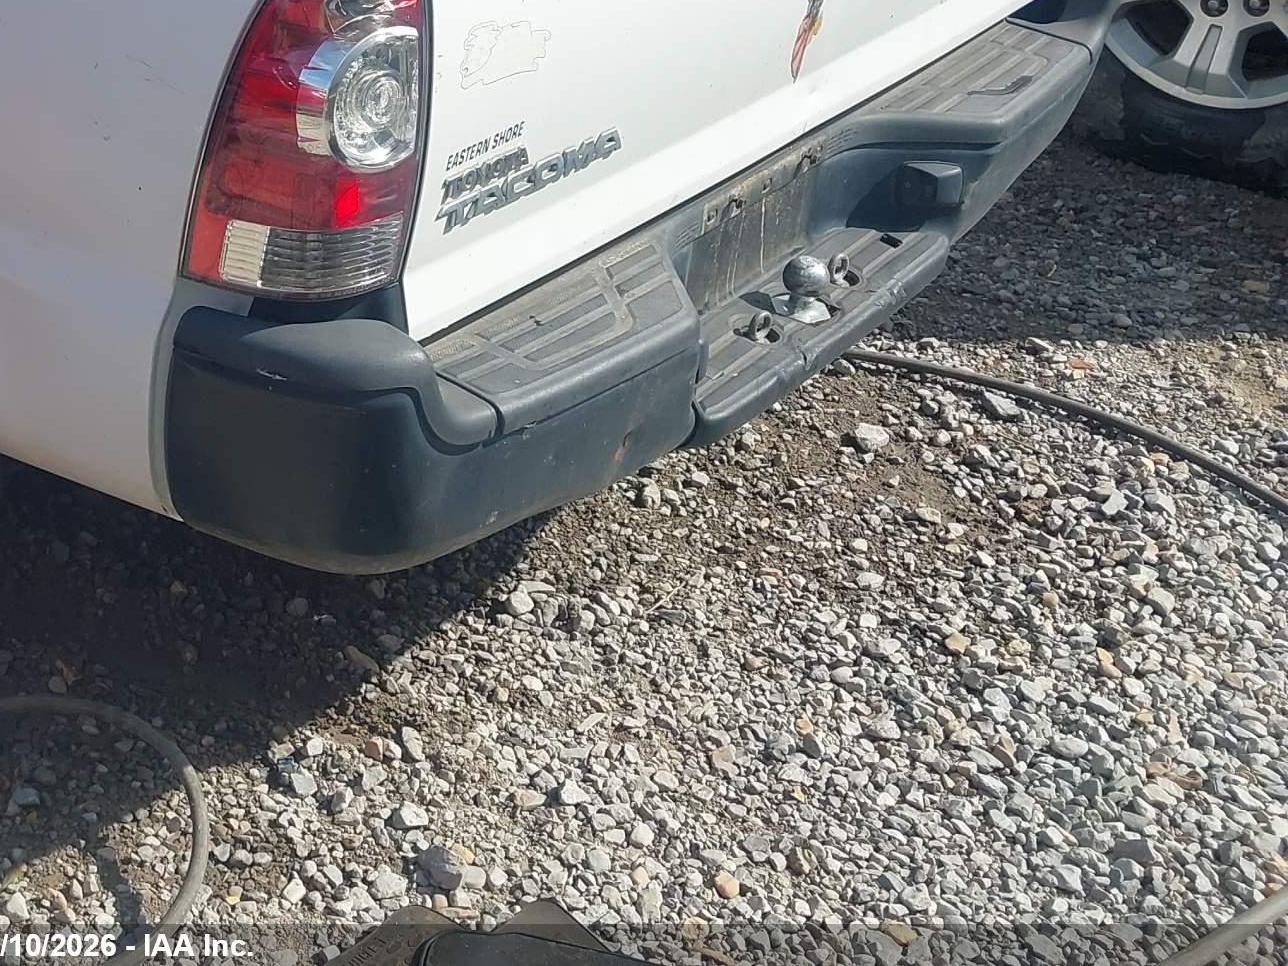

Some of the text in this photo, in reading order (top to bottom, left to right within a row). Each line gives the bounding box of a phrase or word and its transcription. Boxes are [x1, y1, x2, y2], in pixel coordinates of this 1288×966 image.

[440, 144, 530, 205] TOYOTA
[445, 120, 526, 172] EASTERN SHORE
[434, 126, 623, 235] TACOMA
